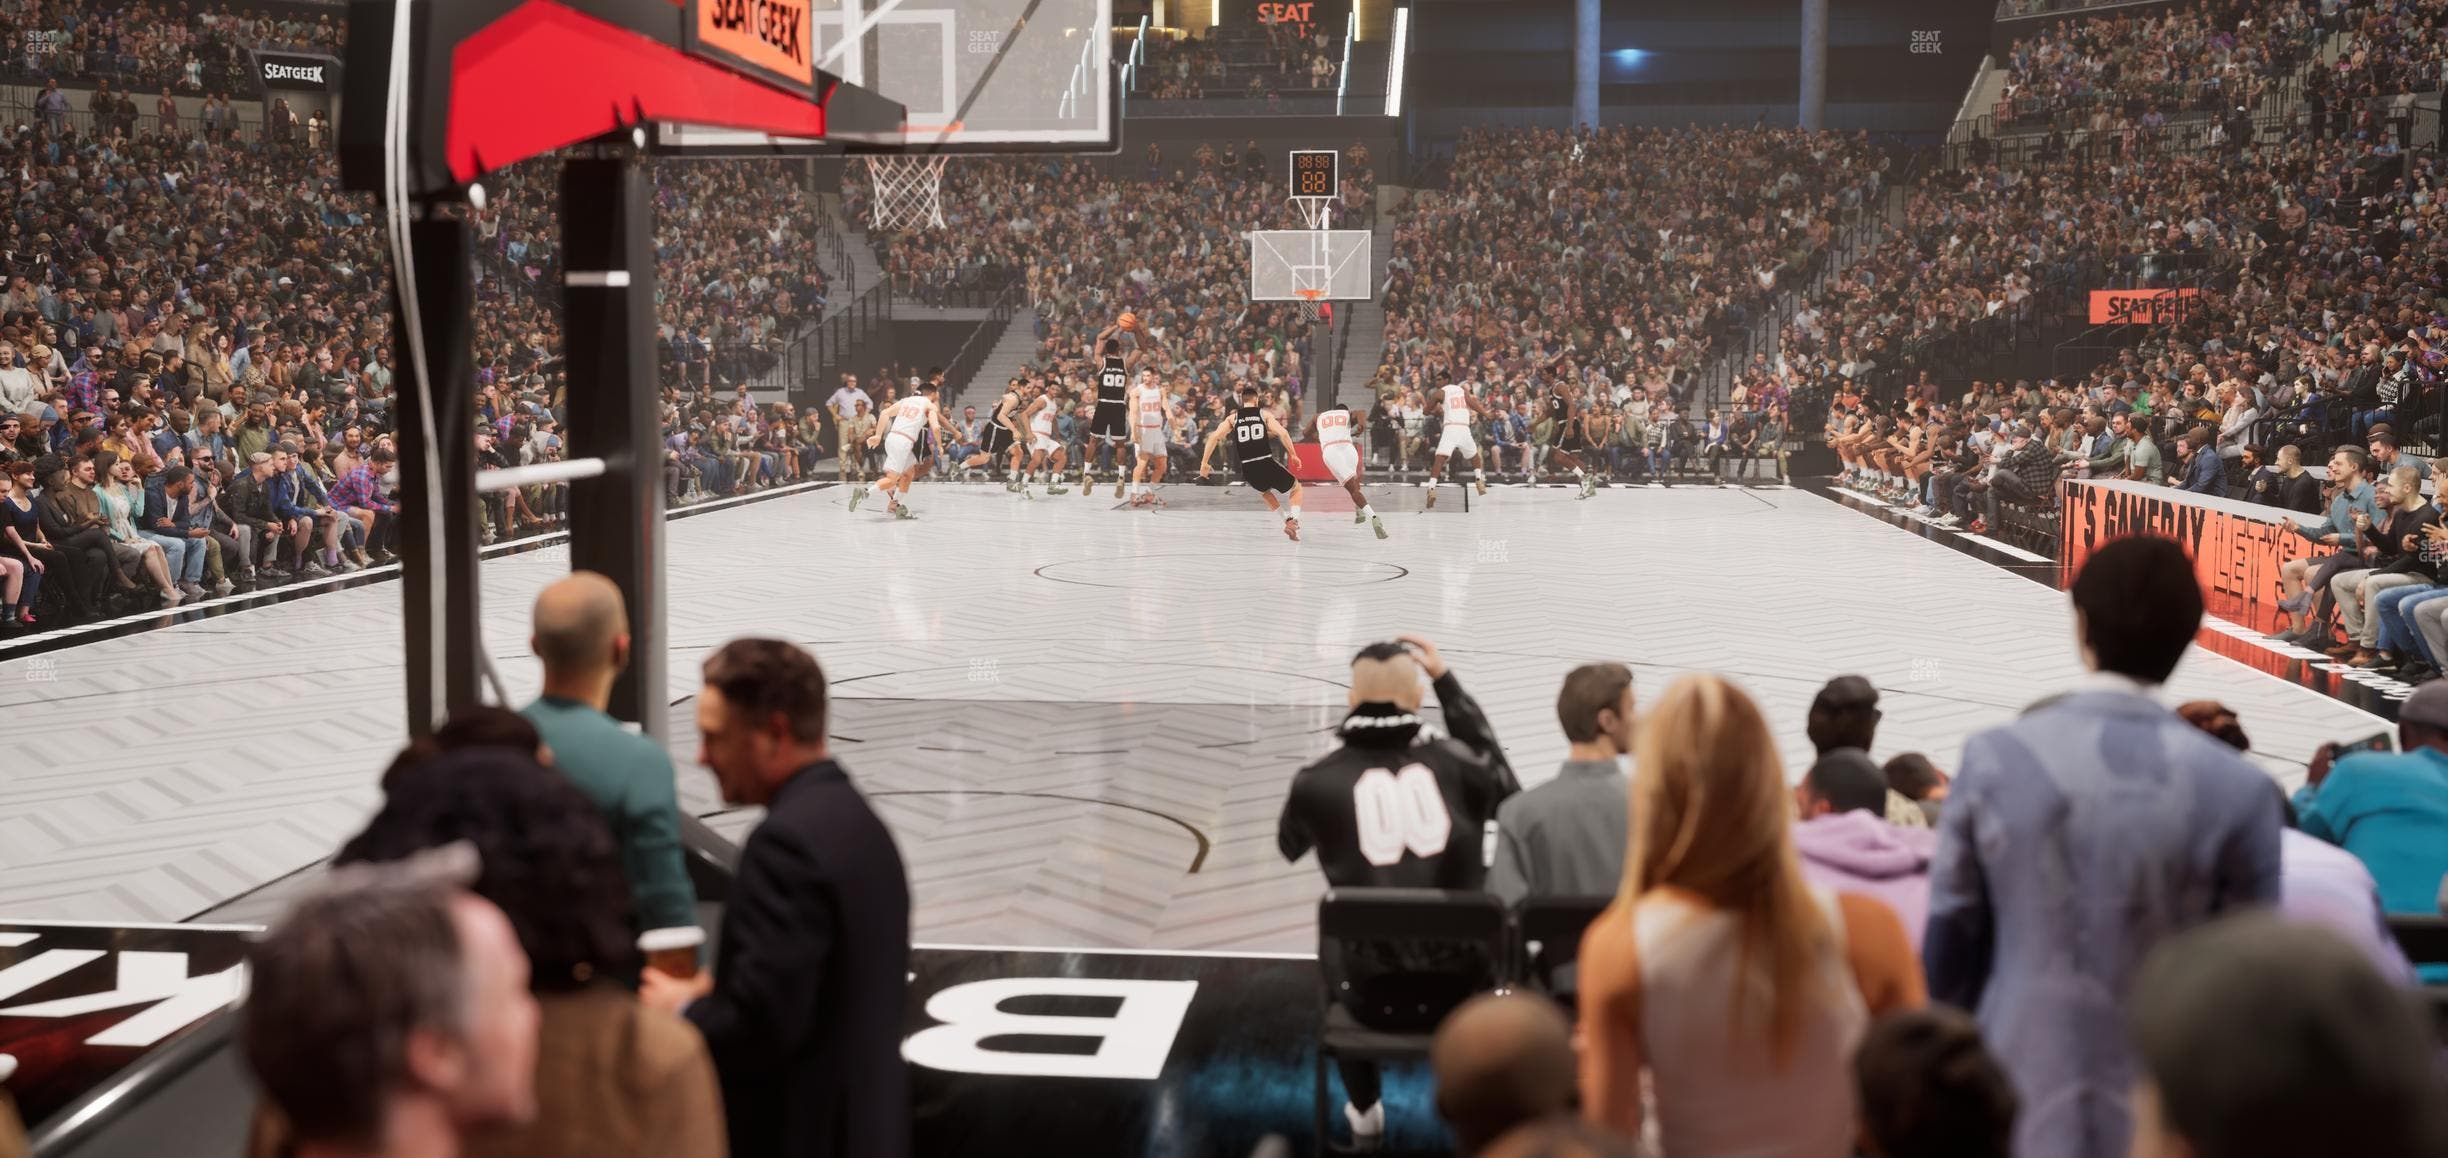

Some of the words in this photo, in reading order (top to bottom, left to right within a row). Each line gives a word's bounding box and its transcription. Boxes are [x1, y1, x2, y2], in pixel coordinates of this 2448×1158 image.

[1257, 2, 1314, 23] SEAT
[264, 62, 324, 83] SEATGEEK
[2108, 296, 2190, 317] SEATGE
[1103, 373, 1126, 388] 00
[1237, 423, 1265, 443] 00
[1353, 762, 1452, 866] 00
